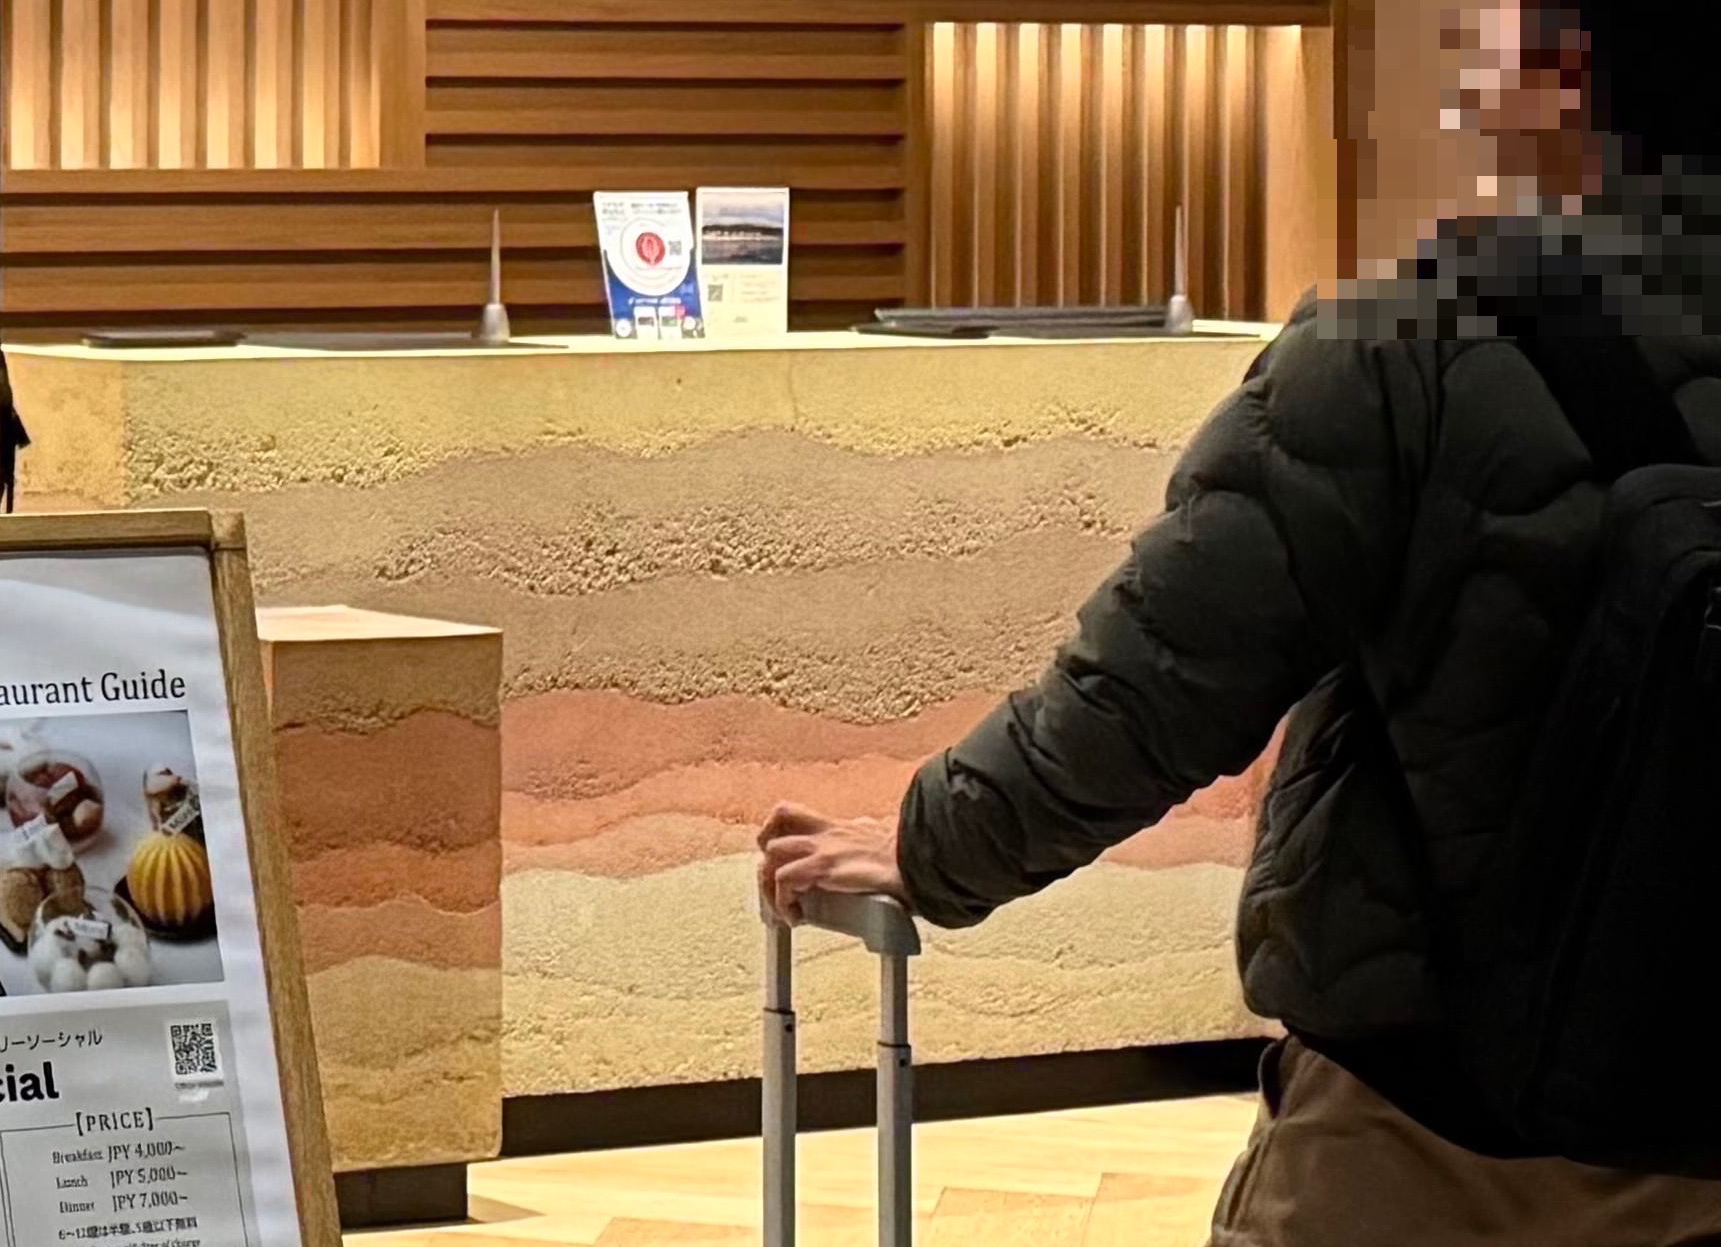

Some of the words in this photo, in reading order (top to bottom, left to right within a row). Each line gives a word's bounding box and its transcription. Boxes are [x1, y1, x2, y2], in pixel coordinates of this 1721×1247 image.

[100, 668, 187, 701] Guide
[52, 1148, 104, 1164] Breakfast
[107, 1144, 131, 1163] JPY
[56, 1175, 89, 1189] Lunch
[110, 1169, 134, 1189] JPY
[112, 1193, 136, 1213] JPY
